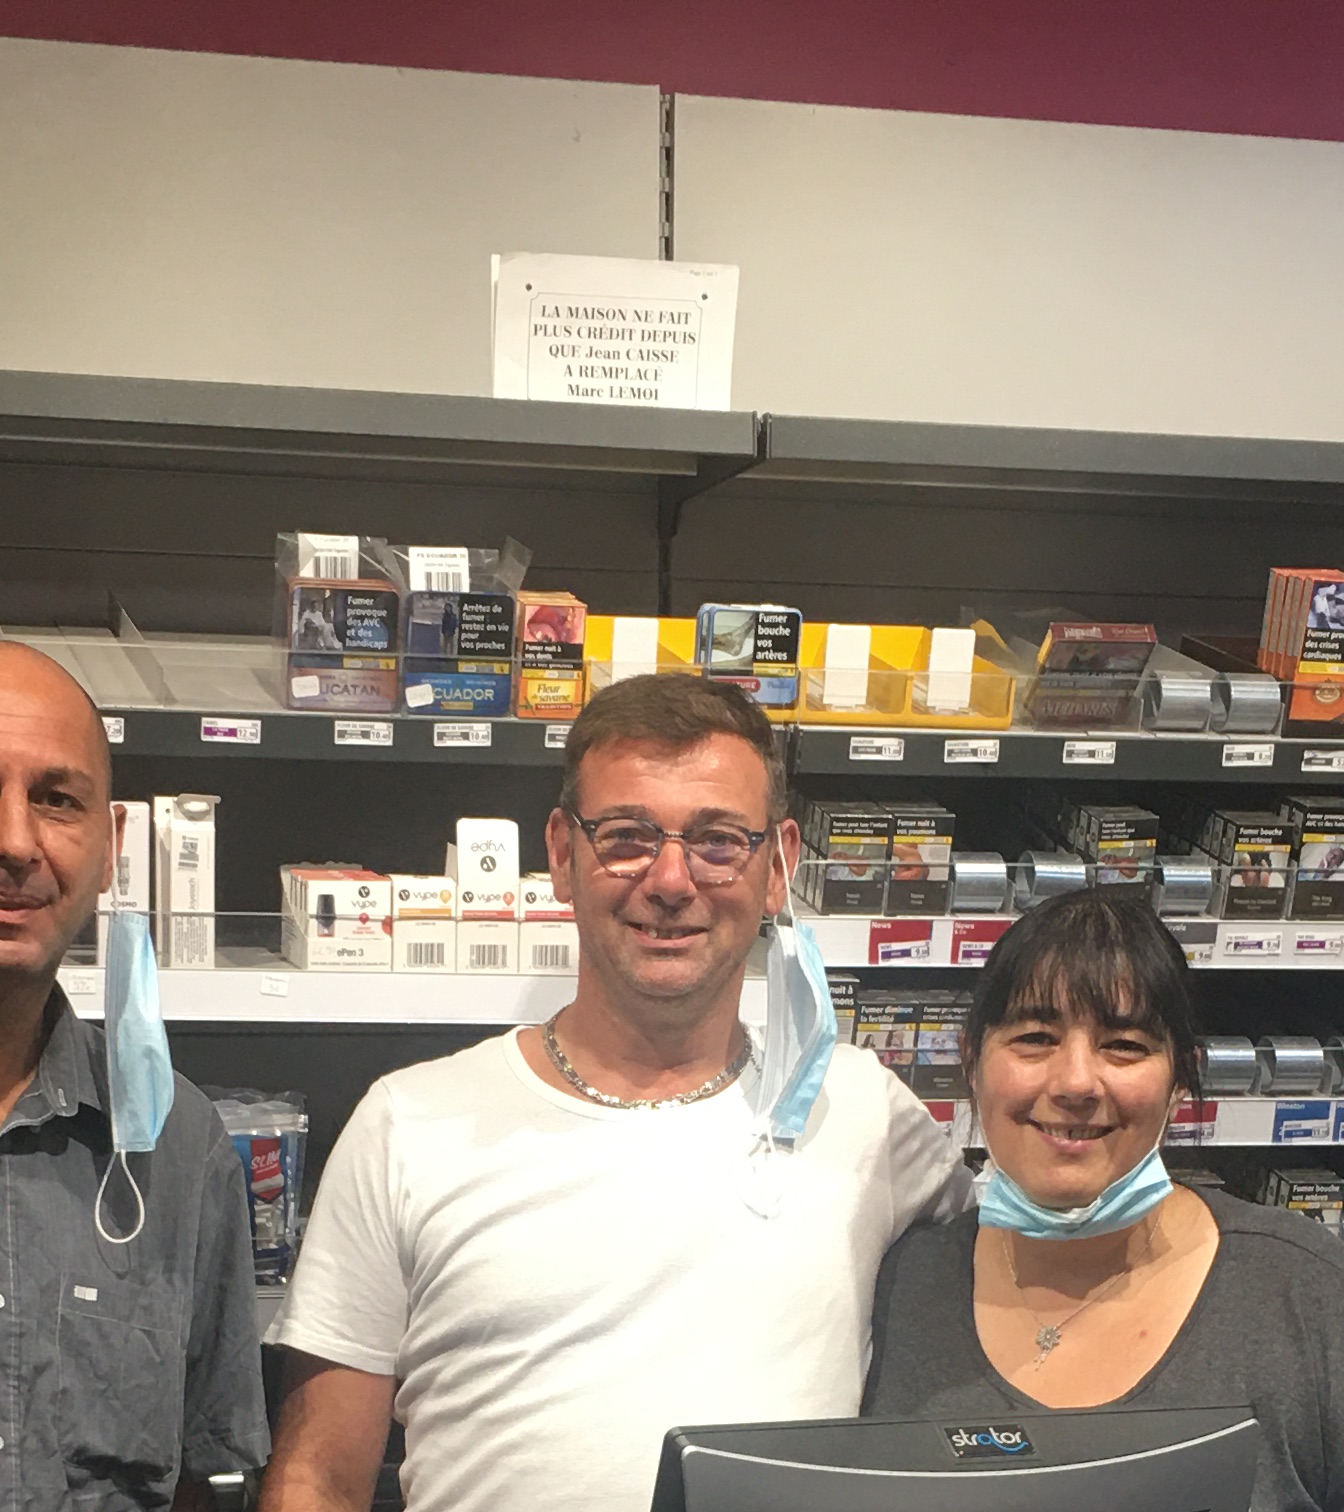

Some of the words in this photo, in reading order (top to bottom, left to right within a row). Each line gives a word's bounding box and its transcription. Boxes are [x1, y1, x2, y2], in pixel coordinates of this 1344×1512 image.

[541, 304, 560, 319] LA
[566, 305, 628, 322] MAISON
[632, 308, 655, 324] NE
[659, 310, 692, 325] FAIT
[533, 323, 572, 339] PLUS
[577, 324, 636, 343] CRÉDIT
[641, 328, 697, 345] DEPUIS
[549, 344, 580, 359] QUE
[585, 346, 621, 362] Jean
[626, 348, 679, 364] CAISSE
[567, 384, 604, 399] Marc
[758, 625, 791, 637] bouche
[432, 687, 495, 701] CUADOR
